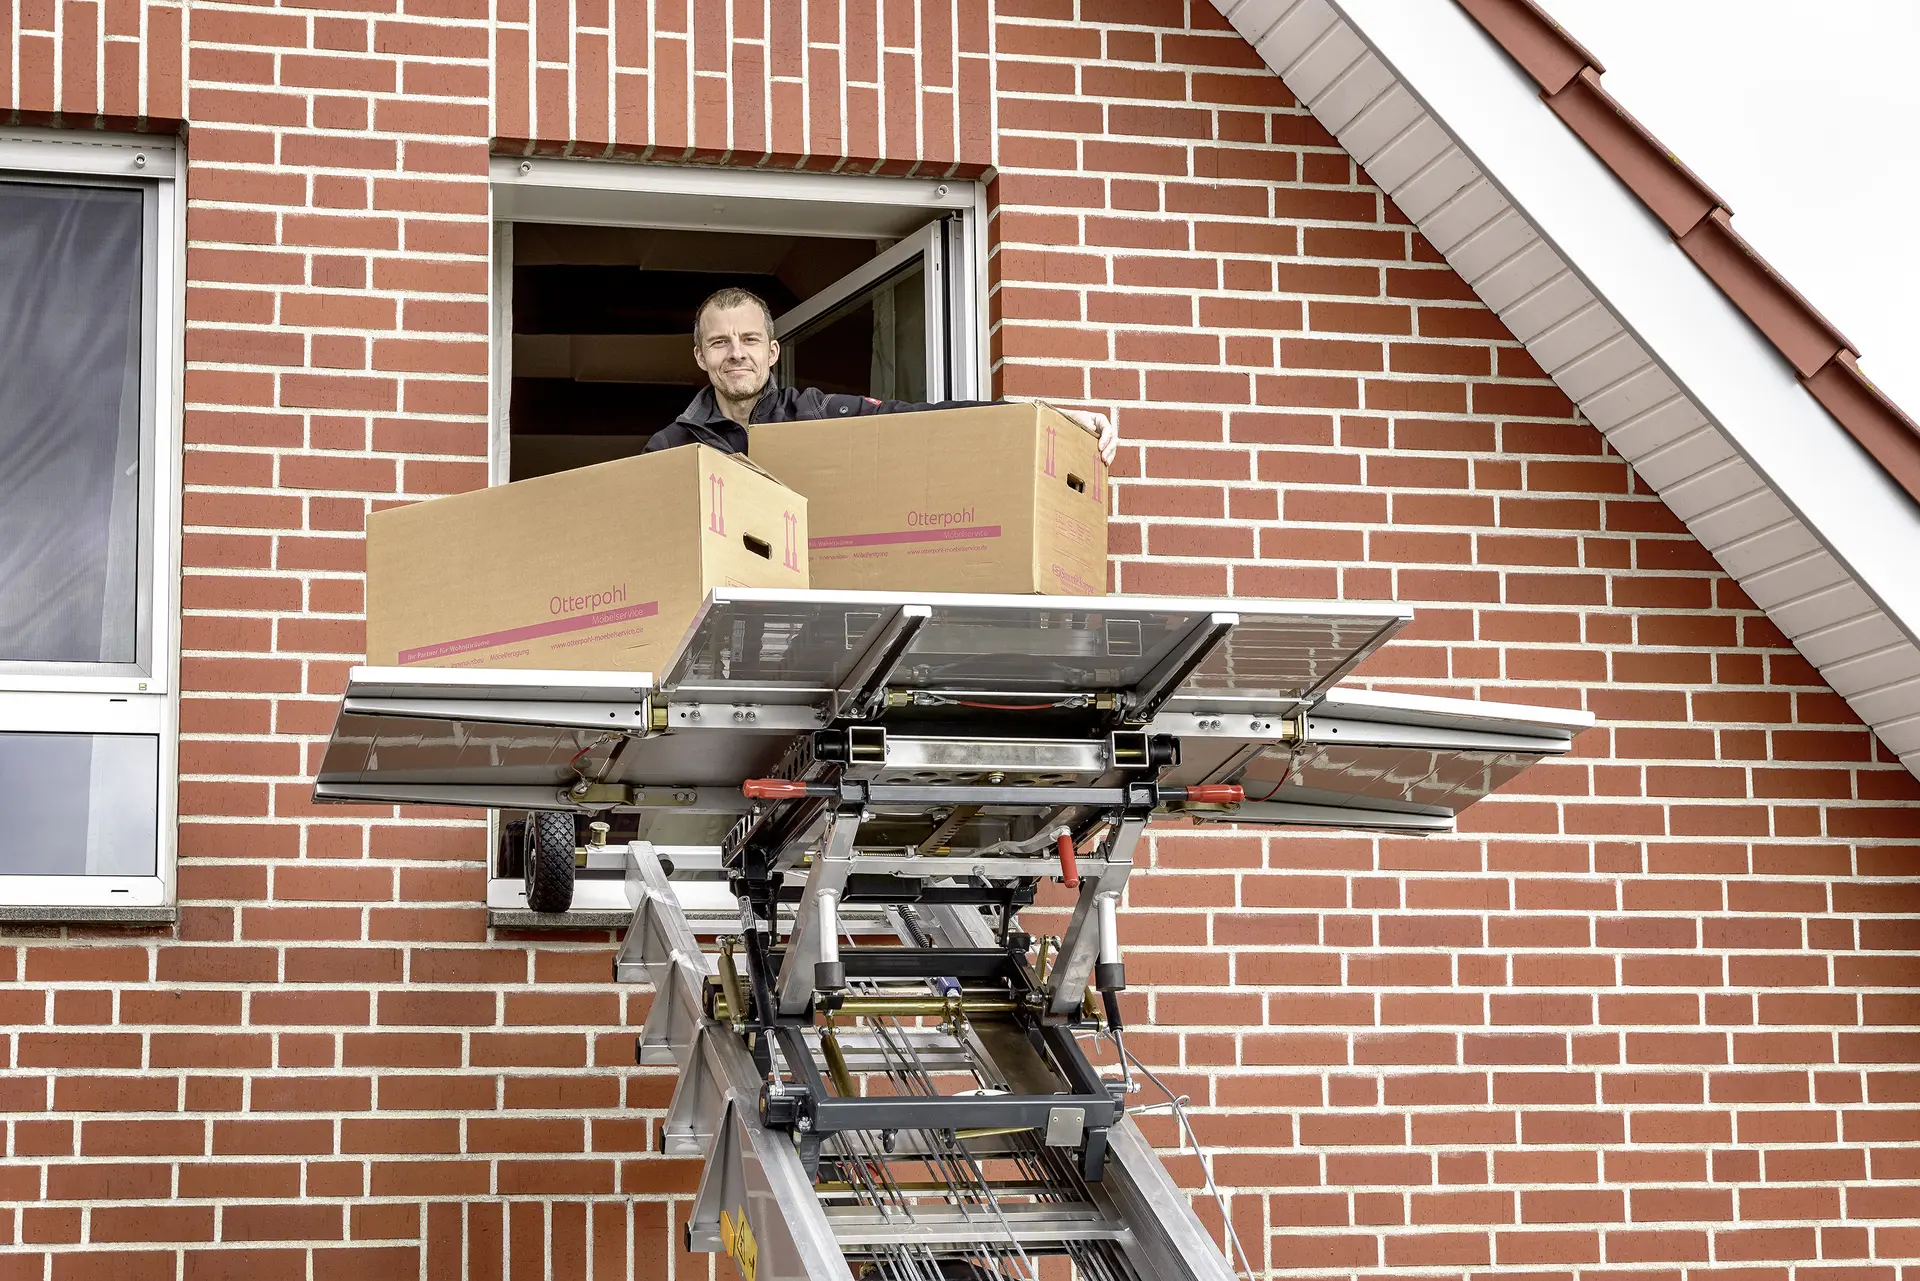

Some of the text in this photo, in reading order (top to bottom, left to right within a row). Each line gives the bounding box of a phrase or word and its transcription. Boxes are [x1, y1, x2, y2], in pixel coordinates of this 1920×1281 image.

[908, 507, 974, 527] Otterpohl
[944, 530, 988, 540] Möbelservice
[907, 545, 987, 555] www.otterpohl-moebelservice.de
[550, 583, 626, 614] Otterpohl
[592, 608, 643, 625] Möbelservice
[550, 627, 644, 650] www.otterpohl-moebelservice.de
[417, 649, 438, 659] Partner
